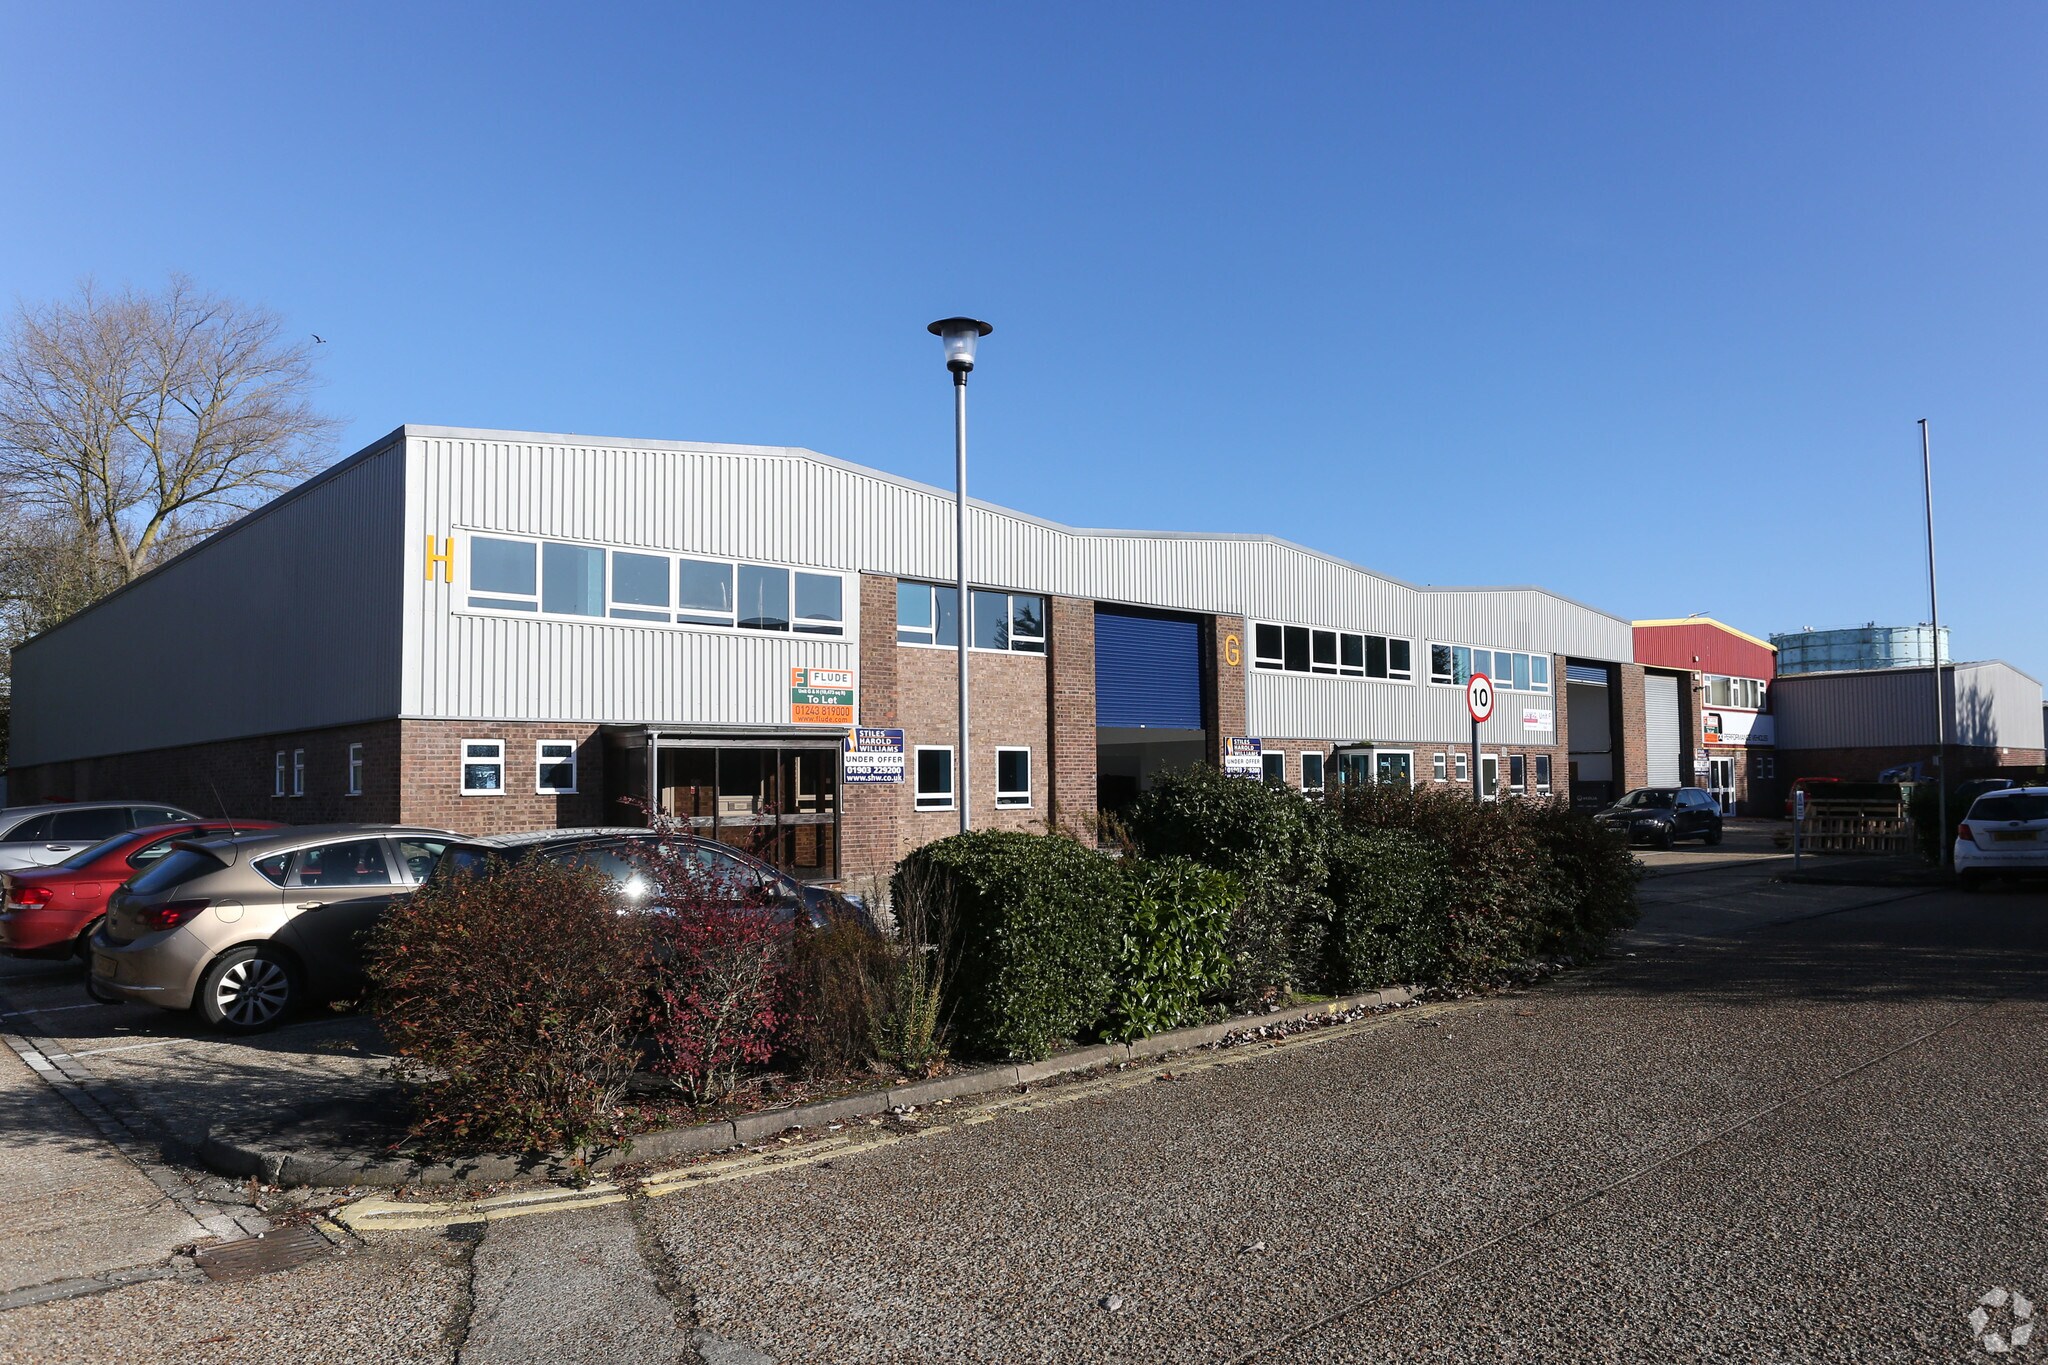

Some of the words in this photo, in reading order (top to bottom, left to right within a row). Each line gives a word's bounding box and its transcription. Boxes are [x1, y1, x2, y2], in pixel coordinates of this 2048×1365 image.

[425, 535, 454, 583] H
[1225, 635, 1240, 666] G
[814, 672, 847, 682] FLUDE
[807, 695, 819, 704] To
[822, 696, 838, 704] Let
[1473, 688, 1488, 707] 10
[796, 705, 820, 715] 01243
[821, 706, 850, 717] 819000
[847, 766, 872, 774] 01903
[846, 773, 902, 781] www.shw.co.uk
